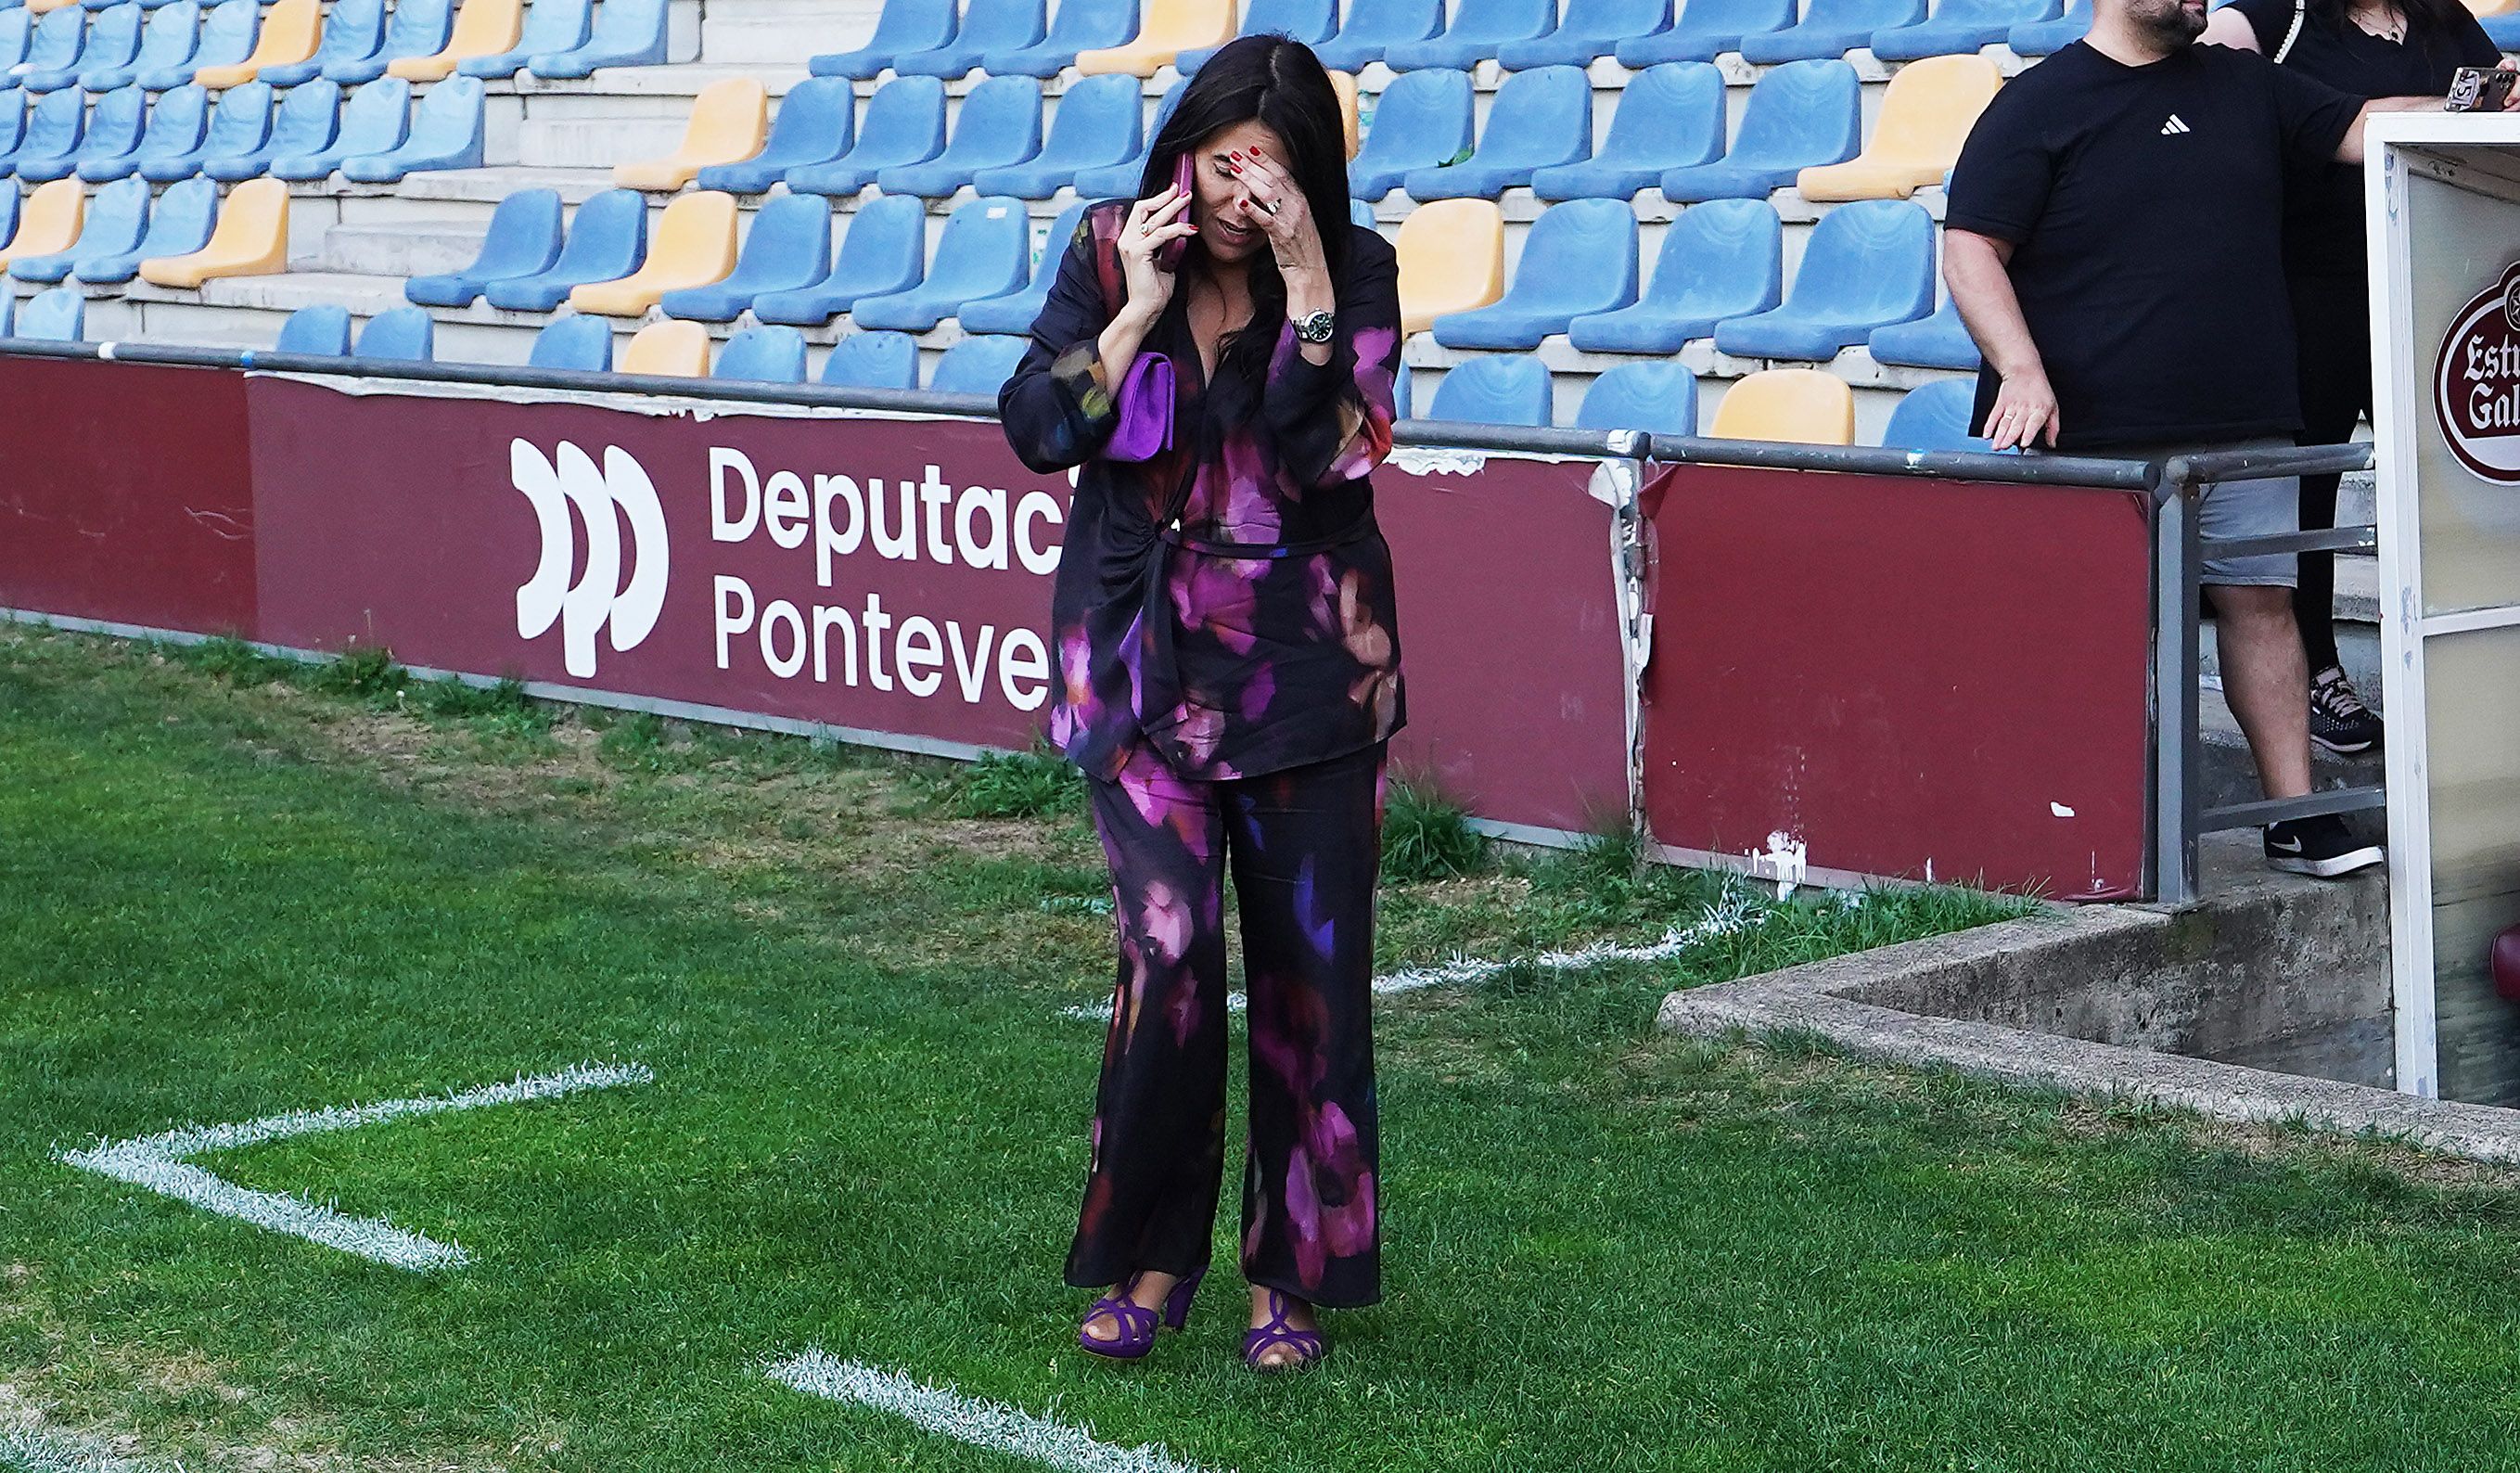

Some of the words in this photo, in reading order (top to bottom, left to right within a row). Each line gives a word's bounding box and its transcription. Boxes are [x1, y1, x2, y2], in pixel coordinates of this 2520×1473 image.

[2469, 382, 2520, 429] Gal
[709, 446, 1081, 587] Deputac
[714, 574, 1050, 711] Ponteve
